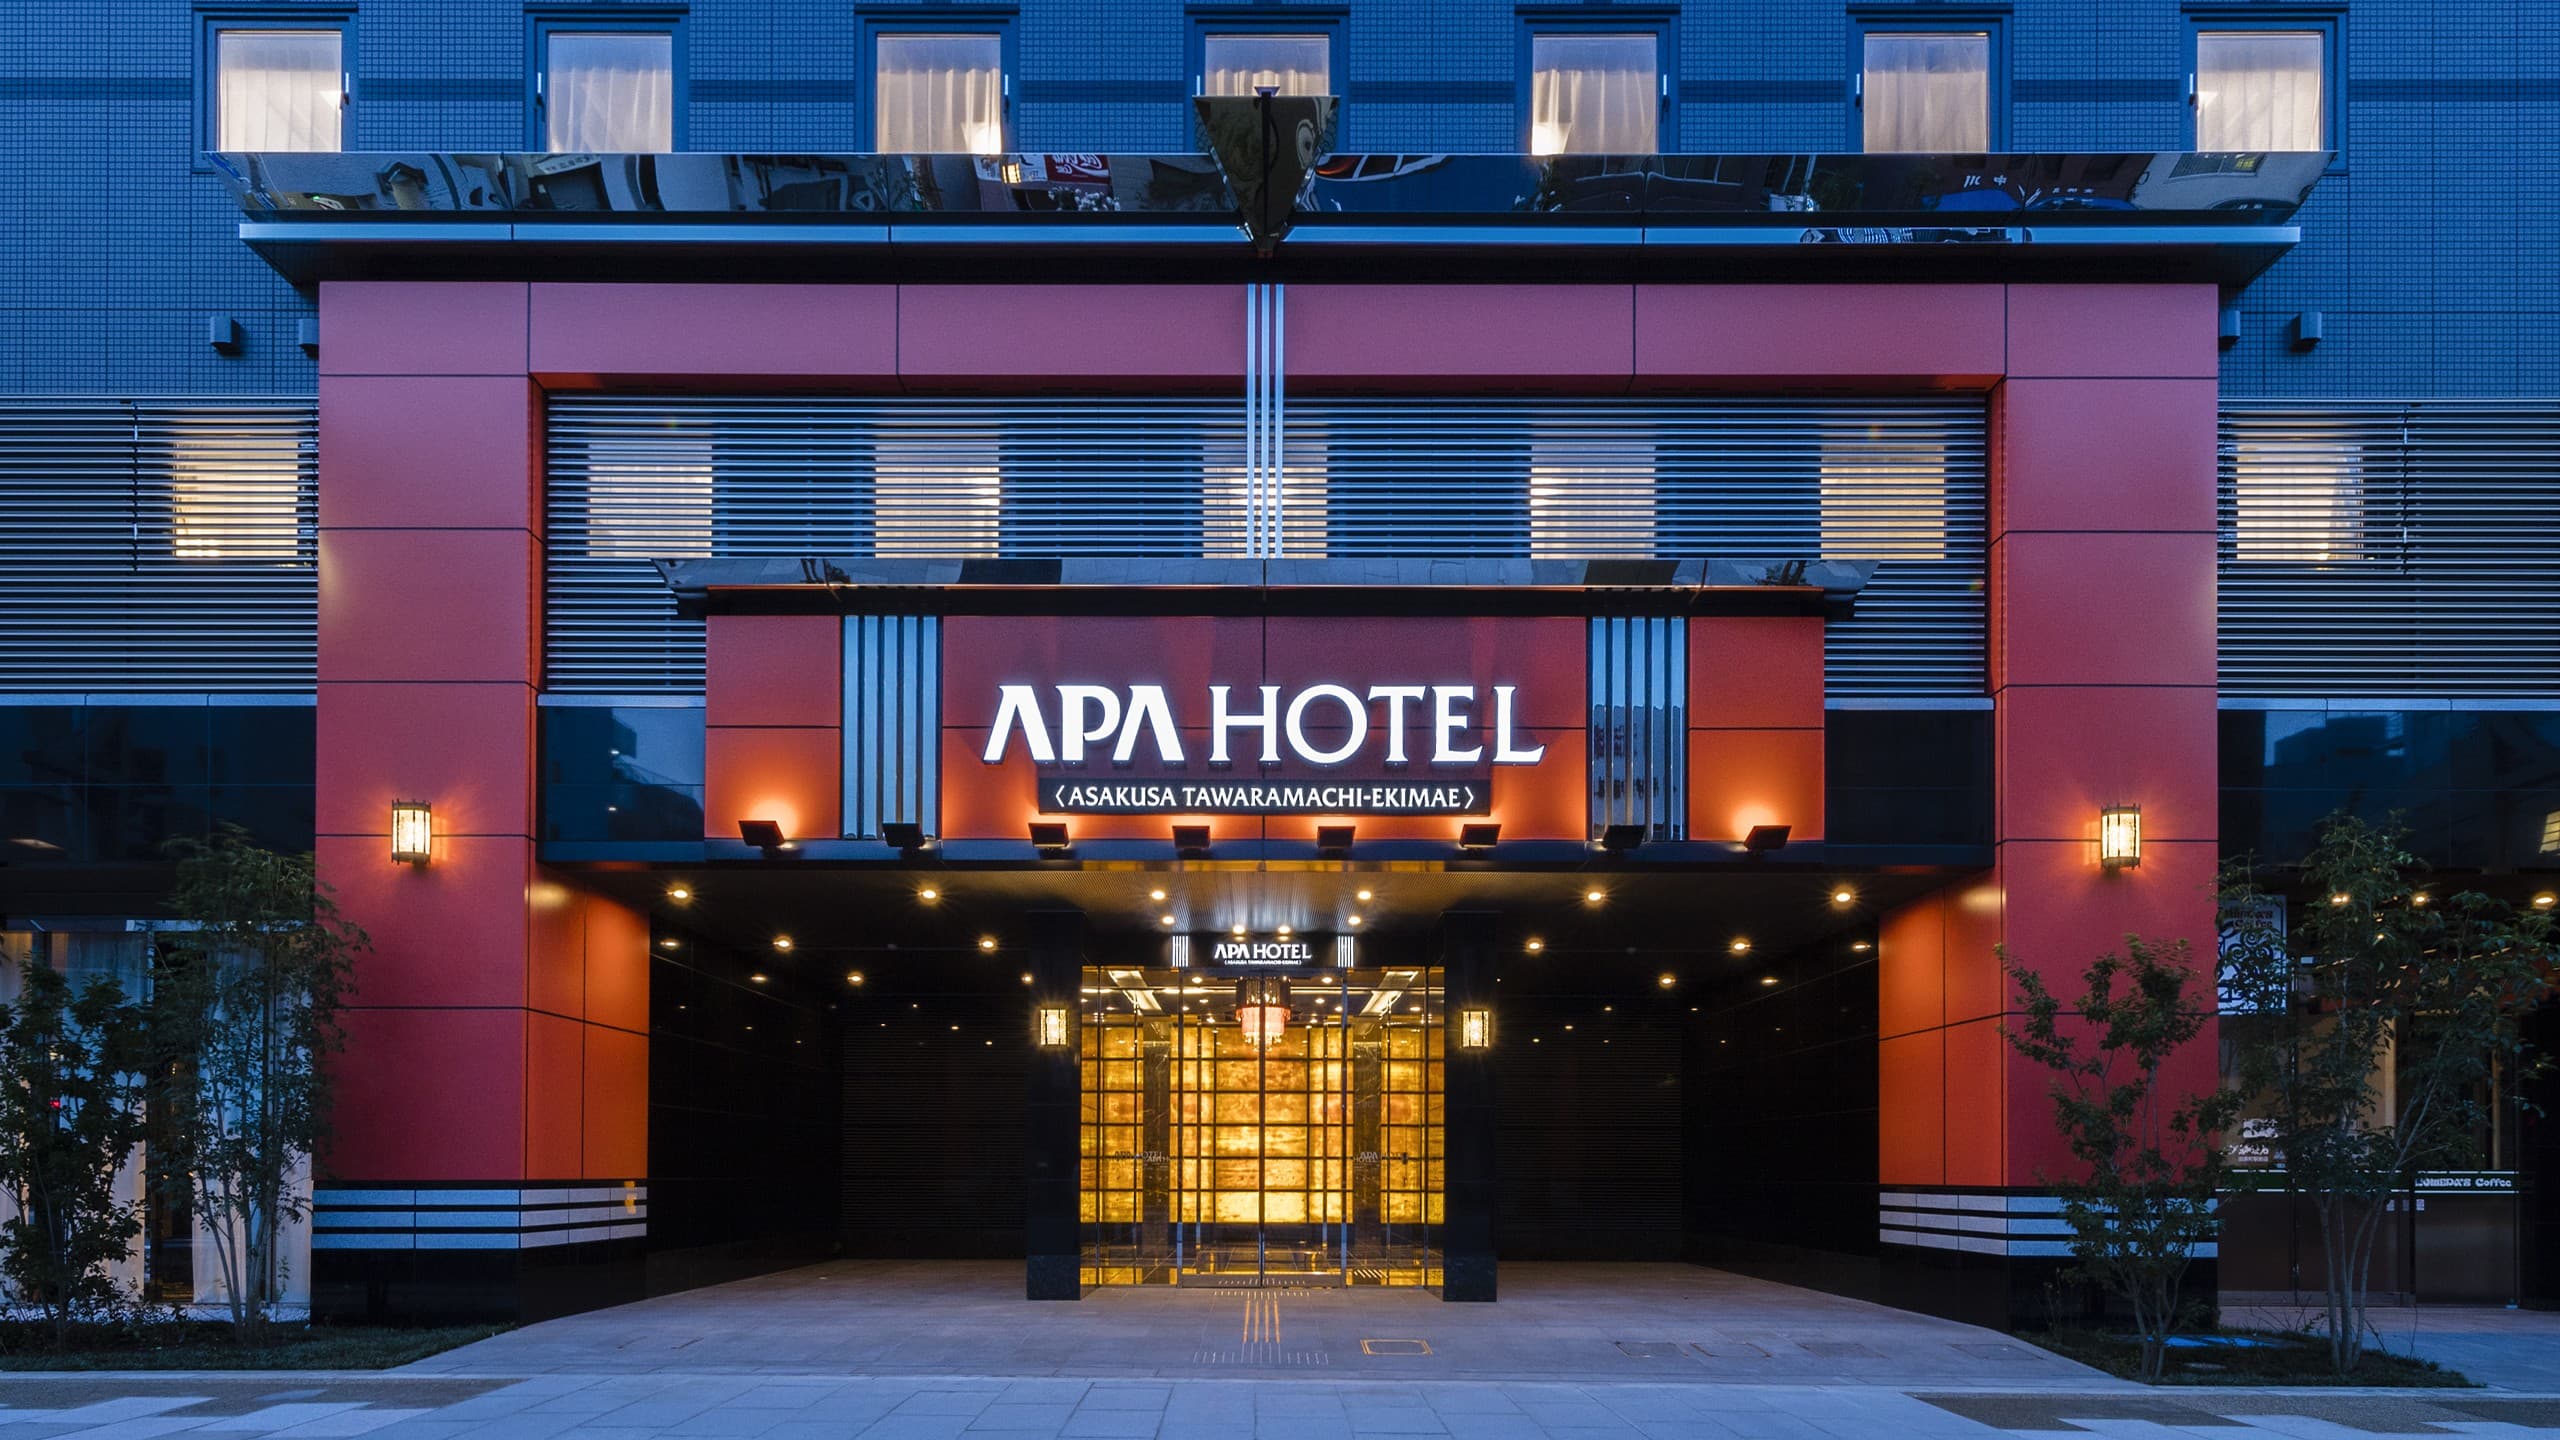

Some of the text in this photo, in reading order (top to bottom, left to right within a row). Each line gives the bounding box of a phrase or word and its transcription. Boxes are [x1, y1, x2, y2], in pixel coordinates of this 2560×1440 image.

[984, 685, 1185, 764] APA
[1209, 684, 1546, 765] HOTEL
[1214, 943, 1312, 959] APA HOTEL
[2475, 1178, 2512, 1187] Coffee
